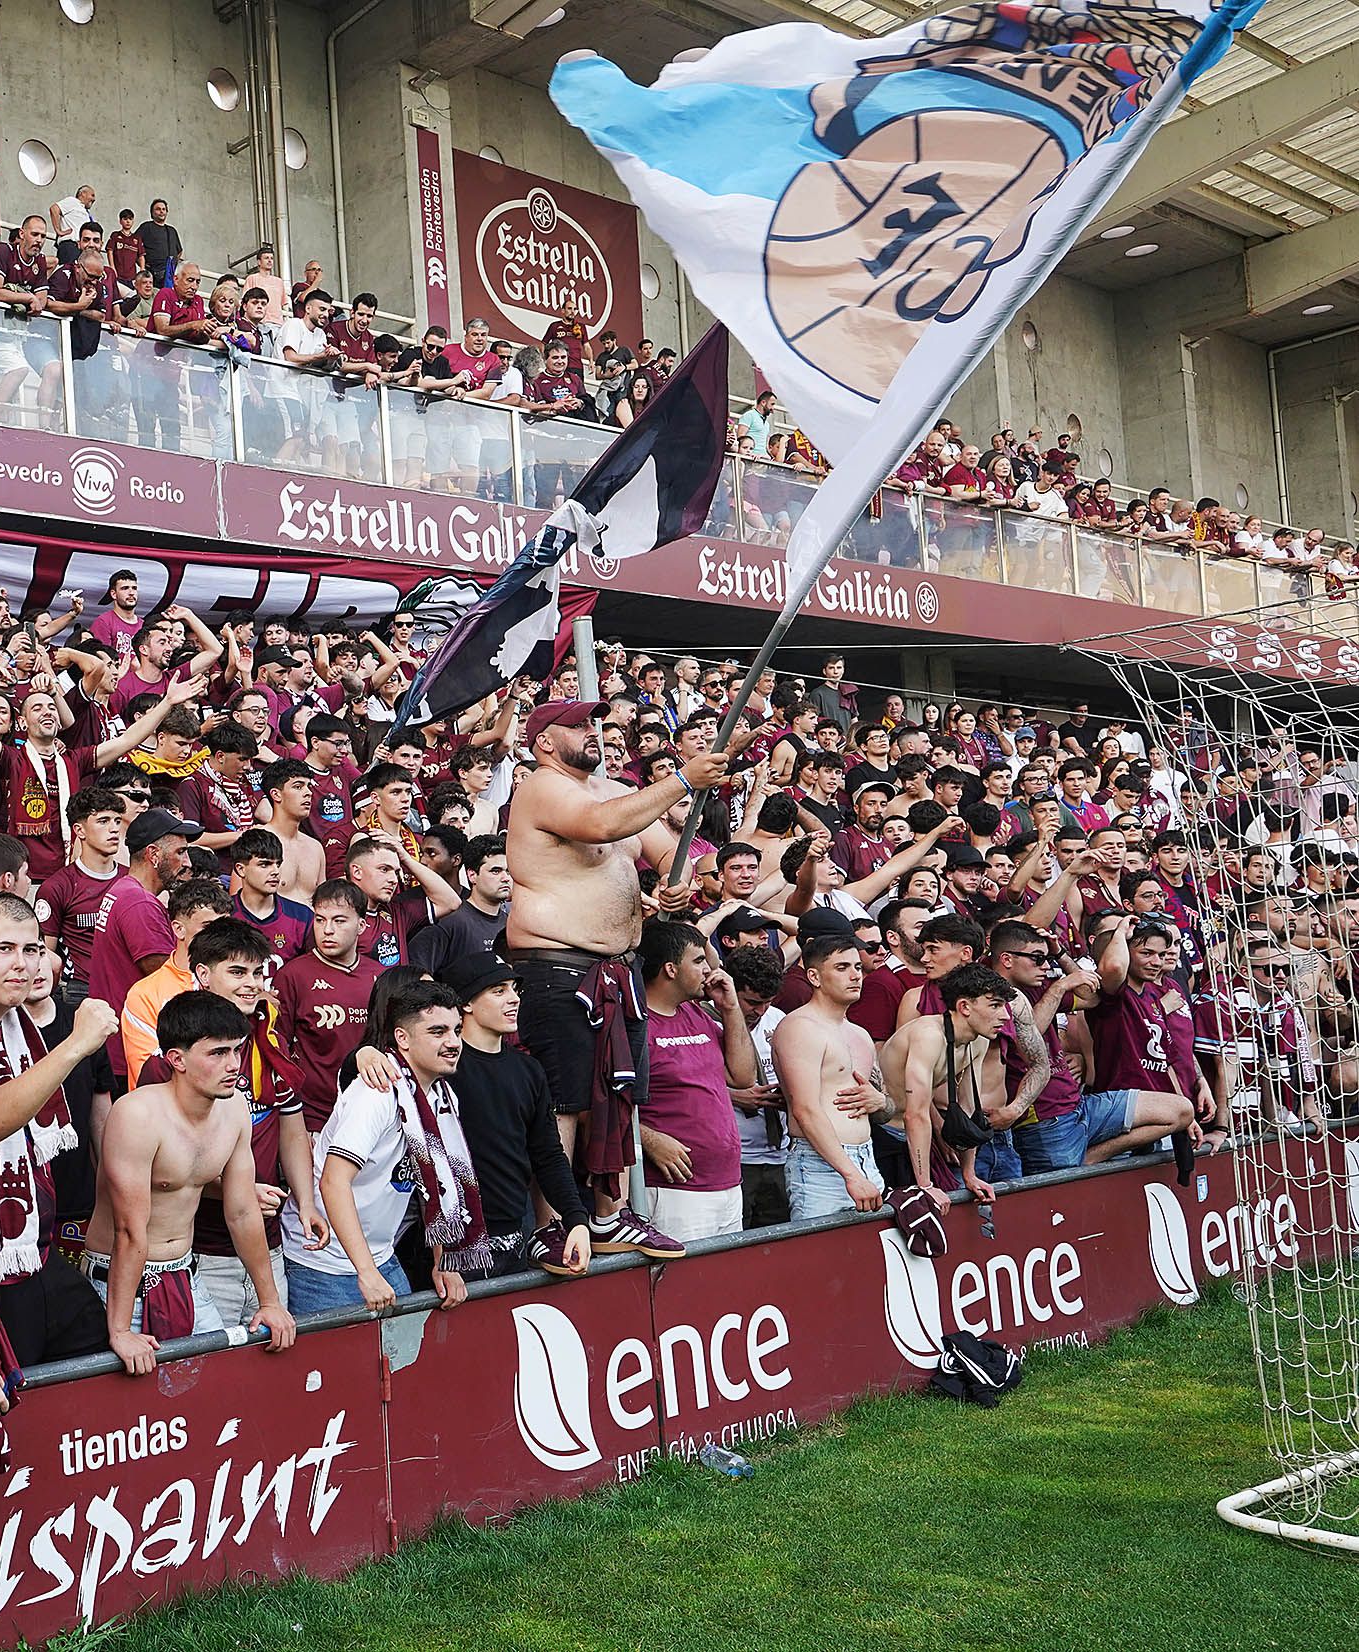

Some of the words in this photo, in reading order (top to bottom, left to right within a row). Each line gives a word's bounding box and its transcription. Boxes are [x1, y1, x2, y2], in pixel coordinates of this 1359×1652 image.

[421, 169, 433, 249] Deputación
[432, 170, 442, 251] Pontevedra
[496, 221, 597, 284] Estrella
[503, 265, 594, 321] Galicia
[76, 468, 115, 493] Viva
[129, 475, 185, 504] Radio
[277, 480, 443, 559] Estrella
[449, 505, 580, 576] Galia
[697, 545, 810, 607] Estrell
[816, 566, 911, 620] Galicia
[1201, 1193, 1300, 1278] ence
[951, 1242, 1085, 1336] ence
[605, 1303, 794, 1431] ence
[59, 1414, 188, 1477] tiendas
[702, 1430, 719, 1448] &
